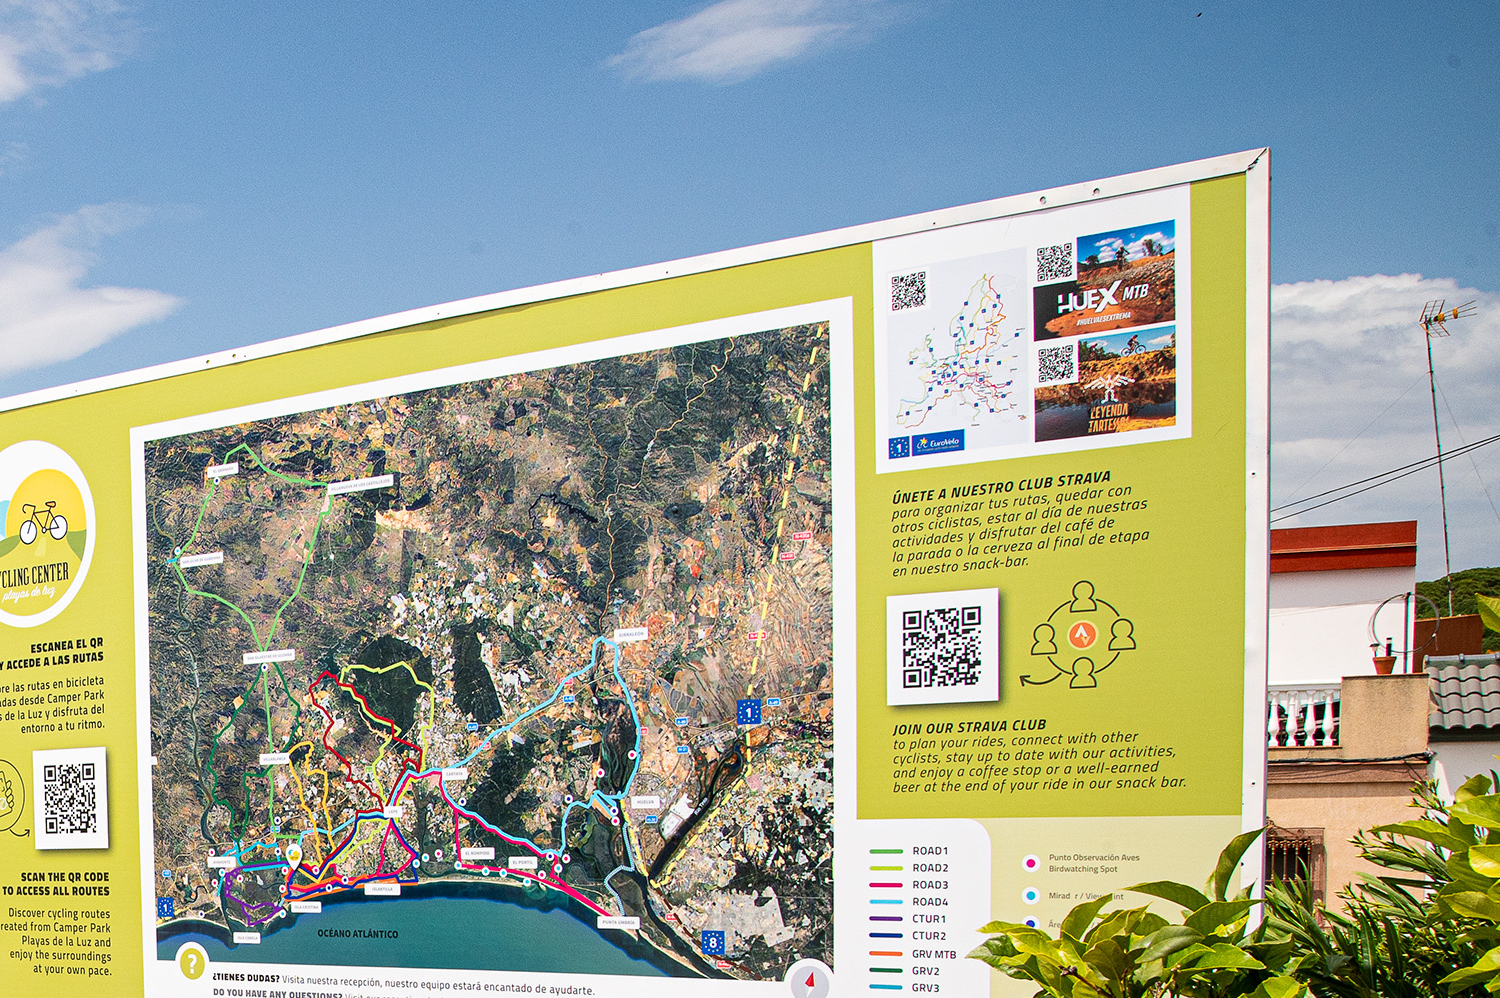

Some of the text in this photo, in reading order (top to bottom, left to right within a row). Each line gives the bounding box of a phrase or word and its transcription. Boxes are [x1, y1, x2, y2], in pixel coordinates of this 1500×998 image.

[1057, 280, 1149, 314] HUEX MTB
[1076, 312, 1132, 326] #HUELVAESEXTREMA
[1090, 402, 1129, 419] LEYENDA
[896, 443, 902, 453] 1
[930, 438, 960, 447] EuroVelo
[892, 470, 1110, 505] ÚNETE A NUESTRO CLUB STRAVA
[891, 486, 1132, 522] para organizar tus rutas, quedar con
[32, 562, 69, 585] CENTER
[1, 585, 56, 604] playas de luz
[31, 637, 103, 654] ESCANEA EL QR
[6, 657, 41, 670] ACCEDE
[43, 657, 50, 667] A
[52, 654, 70, 666] LAS
[72, 651, 104, 664] RUTAS
[12, 683, 25, 692] las
[27, 681, 50, 691] rutas
[53, 680, 63, 689] en
[66, 676, 104, 688] bicicleta
[19, 694, 45, 706] desde
[47, 693, 81, 705] Camper
[84, 689, 105, 701] Park
[746, 707, 751, 718] 1
[892, 719, 1047, 736] JOIN OUR STRAVA CLUB
[893, 731, 1139, 752] to plan your rides, connect with other
[913, 846, 948, 855] ROAD1
[1073, 853, 1120, 861] Observación
[913, 863, 948, 872] ROAD2
[1049, 865, 1118, 874] Birdwatching Spot
[21, 872, 109, 883] SCAN THE QR CODE
[913, 880, 949, 890] ROAD3
[2, 886, 110, 896] TO ACCESS ALL ROUTES
[1048, 892, 1079, 900] Miradr
[913, 897, 948, 906] ROAD4
[8, 907, 110, 921] Discover cycling routes
[163, 904, 168, 913] 1
[912, 914, 946, 923] CTUR1
[317, 927, 399, 939] OCÉANO ATLÁNTICO
[912, 931, 946, 941] CTUR2
[709, 937, 717, 949] 8
[10, 949, 112, 965] enjoy the surroundings
[912, 949, 957, 959] GRV MTB
[912, 966, 940, 976] GRV2
[212, 973, 595, 996] ¿TIENES DUDAS? Visita nuestra recepción, nuestro equipo estará encantado de ayudarte.
[912, 983, 940, 993] GRV3
